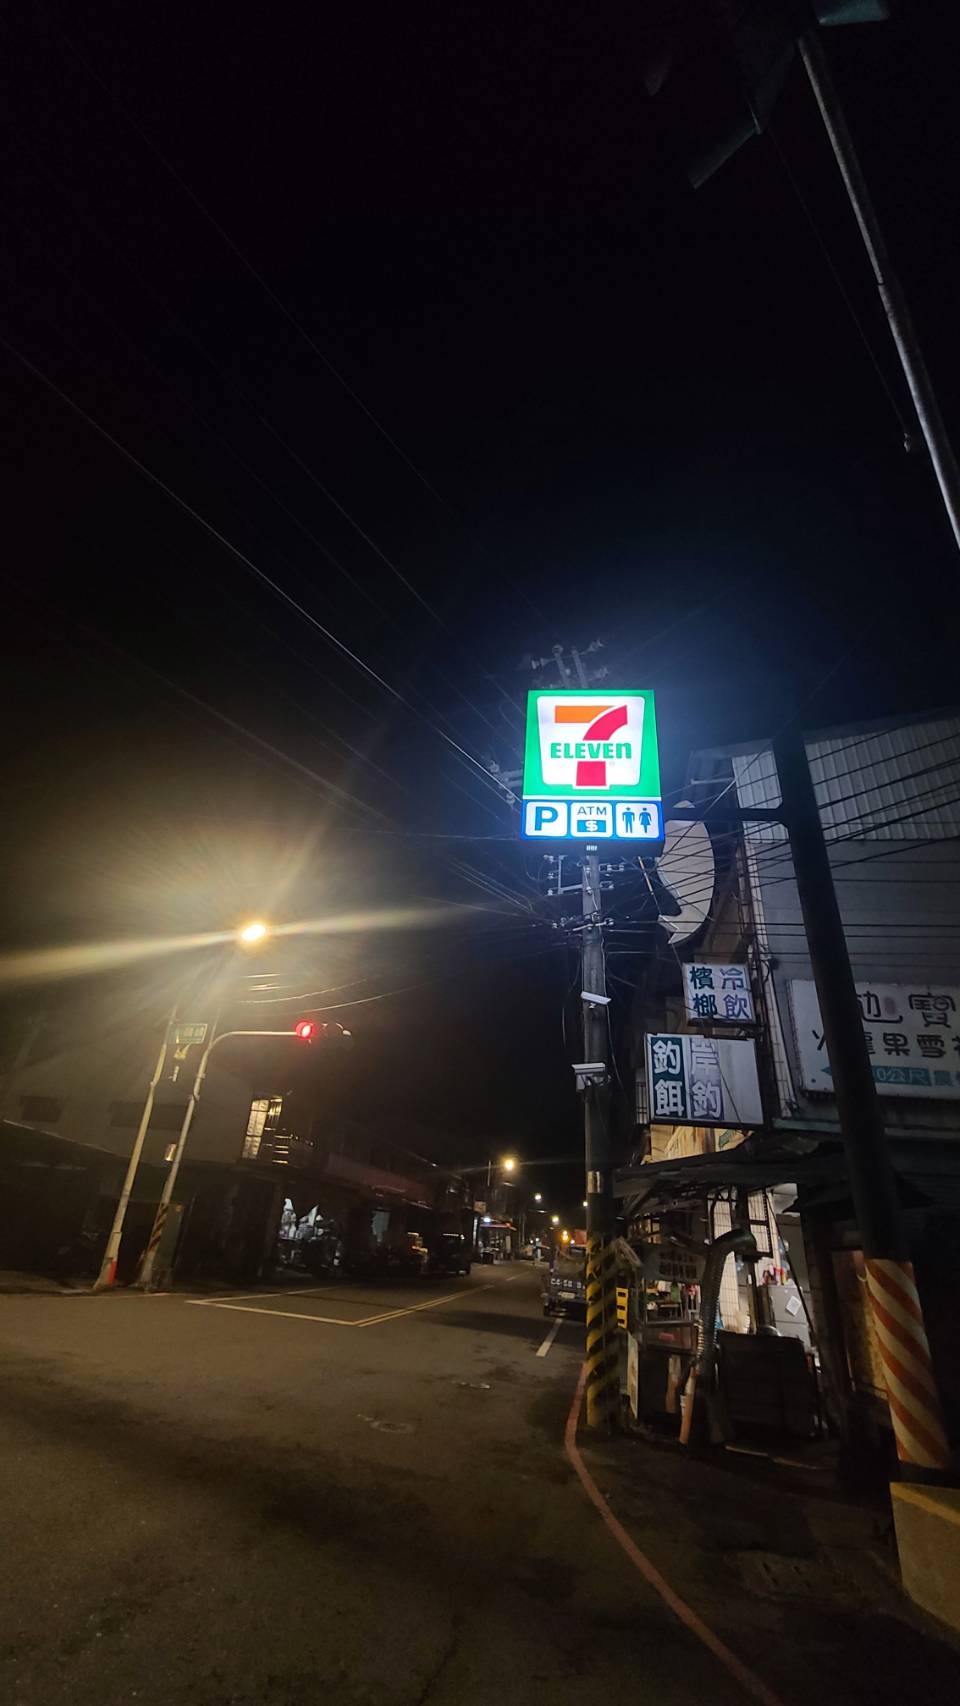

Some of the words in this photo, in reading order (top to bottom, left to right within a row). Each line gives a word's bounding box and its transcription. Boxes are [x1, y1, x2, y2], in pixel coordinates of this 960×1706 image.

[554, 704, 628, 786] 7
[534, 806, 559, 831] P
[577, 806, 607, 816] ATM
[689, 966, 718, 1018] 檳榔
[720, 967, 750, 1019] 冷飲
[652, 1040, 685, 1116] 釣餌
